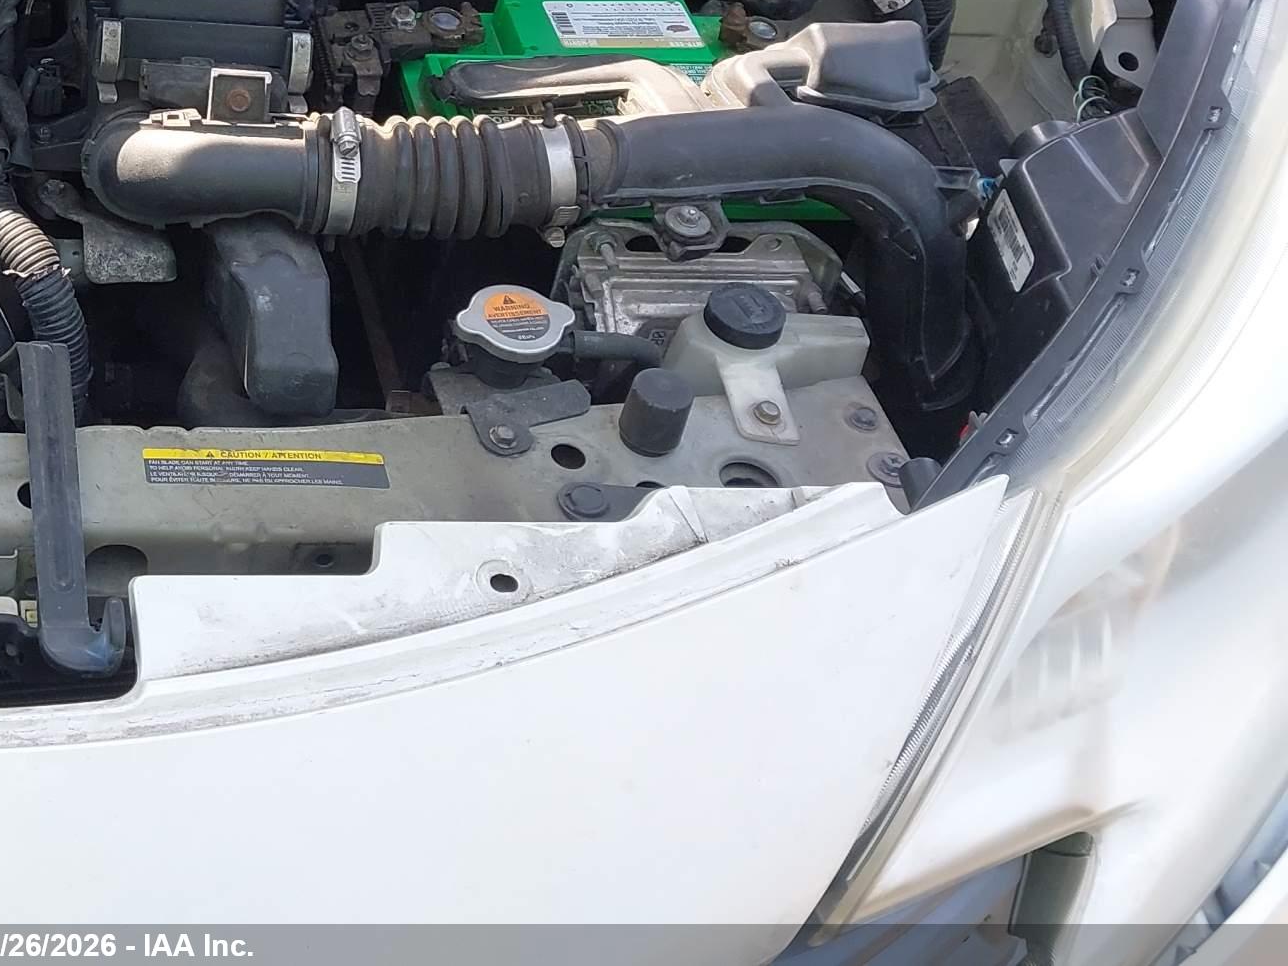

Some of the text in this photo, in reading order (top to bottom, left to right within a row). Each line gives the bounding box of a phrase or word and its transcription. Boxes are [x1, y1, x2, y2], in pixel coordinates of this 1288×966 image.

[493, 303, 530, 312] WARNING
[487, 309, 542, 318] AVERTISSEMENT
[220, 451, 261, 459] CAUTION
[272, 452, 322, 460] ATTENTION
